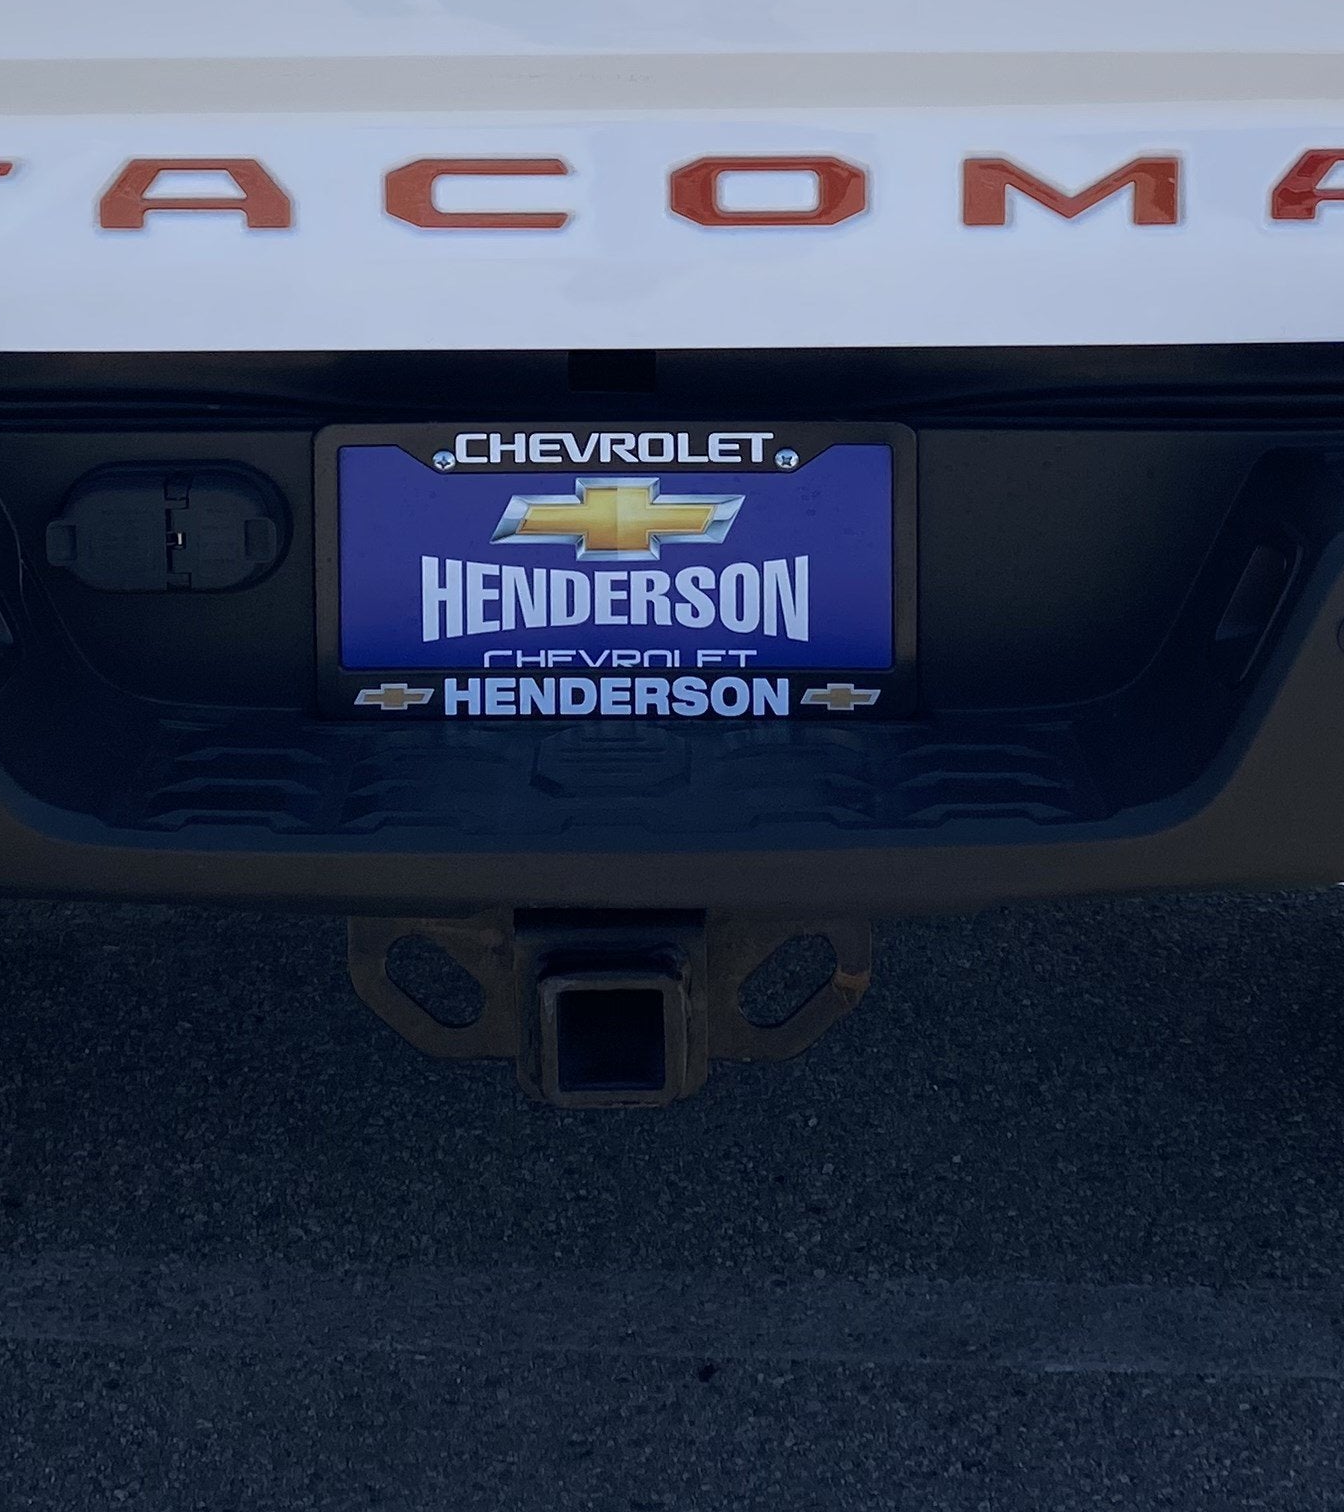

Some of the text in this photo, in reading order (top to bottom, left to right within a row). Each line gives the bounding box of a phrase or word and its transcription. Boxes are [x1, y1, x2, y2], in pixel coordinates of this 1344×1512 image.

[455, 432, 775, 464] CHEVROLET
[421, 554, 810, 643] HENDERSON
[444, 676, 790, 717] HENDERSON
